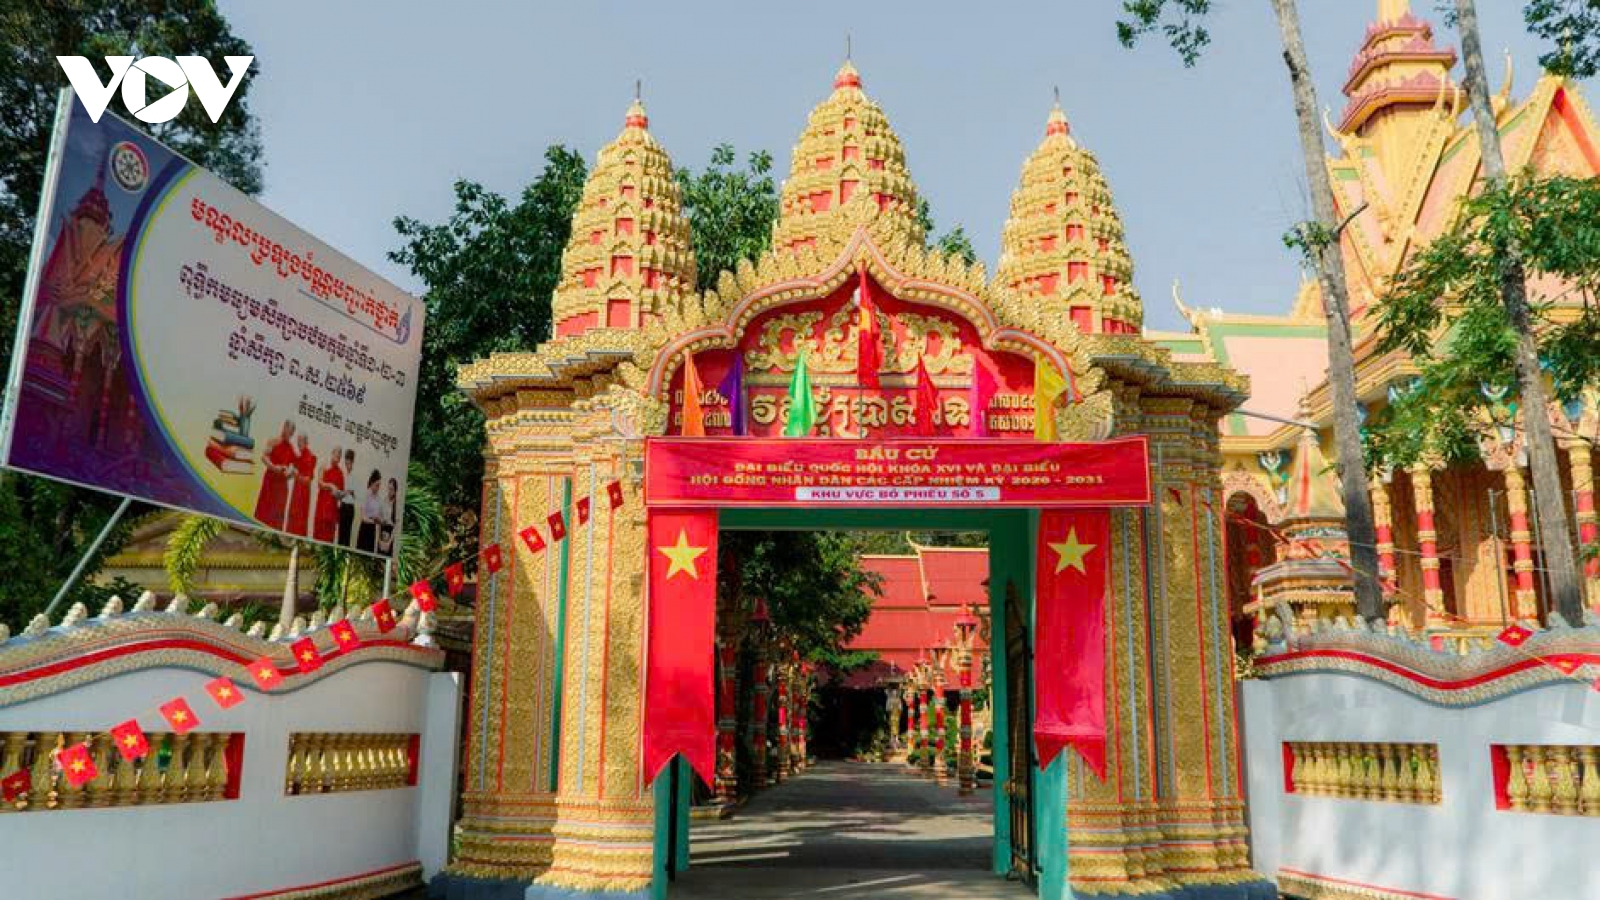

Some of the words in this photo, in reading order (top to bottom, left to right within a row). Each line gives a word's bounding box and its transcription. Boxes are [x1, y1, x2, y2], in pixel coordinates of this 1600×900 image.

[906, 445, 939, 460] CỬ
[734, 462, 762, 473] ĐẠI
[766, 459, 804, 472] BIỂU
[808, 461, 851, 473] QUỐC
[856, 462, 883, 474] HỘI
[936, 463, 961, 474] XVI
[965, 462, 987, 474] VÀ
[992, 463, 1018, 474] ĐẠI
[1023, 459, 1060, 473] BIỂU
[691, 473, 718, 485] HỘI
[722, 473, 766, 485] ĐỒNG
[771, 474, 814, 486] NHÂN
[819, 474, 852, 486] DÂN
[856, 474, 888, 486] CÁC
[893, 474, 924, 486] CẤP
[928, 474, 980, 486] NHIỆM
[984, 474, 1005, 485] KỲ
[1065, 474, 1103, 484] 2031
[810, 489, 841, 499] KHU
[846, 489, 875, 499] VỰC
[878, 488, 899, 499] BỎ
[904, 488, 947, 499] PHIẾU
[951, 487, 971, 499] SỐ
[975, 489, 985, 499] 5
